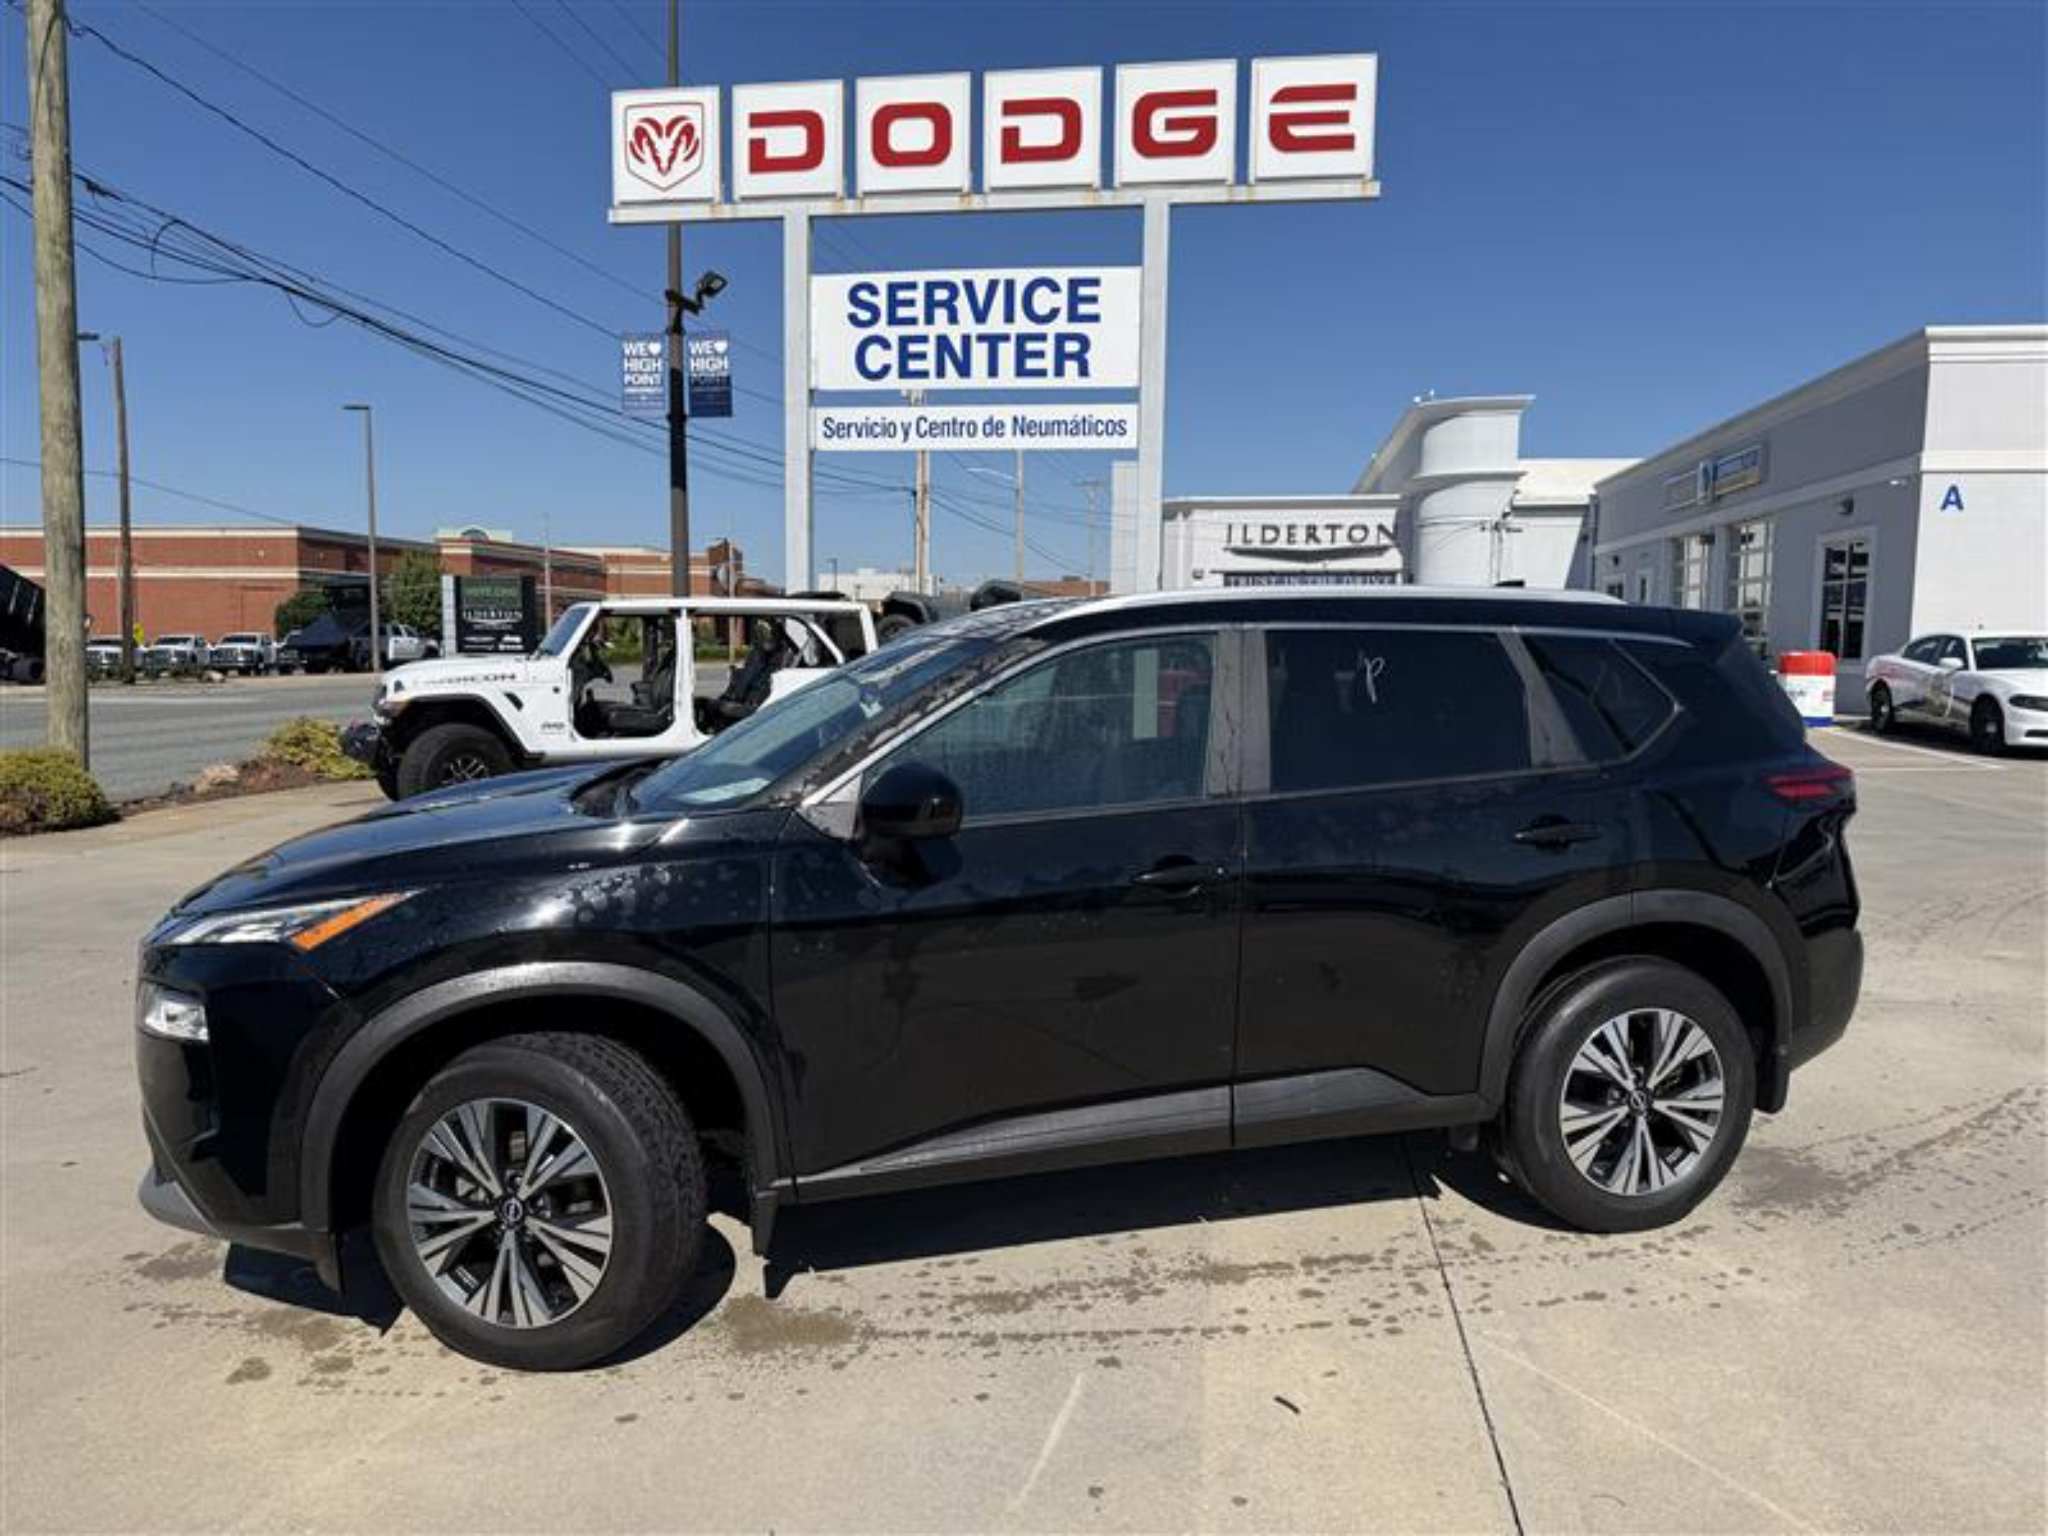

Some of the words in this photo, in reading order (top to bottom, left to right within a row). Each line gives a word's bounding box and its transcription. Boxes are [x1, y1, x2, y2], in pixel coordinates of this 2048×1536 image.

[748, 83, 1357, 174] DODGE
[847, 277, 1101, 328] SERVICE
[623, 341, 648, 356] WE
[689, 341, 714, 355] WE
[855, 332, 1091, 381] CENTER
[623, 357, 662, 372] HIGH
[690, 355, 729, 370] HIGH
[623, 372, 662, 385] POINT
[823, 416, 897, 439] Servicio
[901, 418, 912, 443] y
[915, 416, 978, 439] Centro
[982, 416, 1006, 438] de
[1012, 414, 1128, 438] Neumáticos
[1940, 484, 1965, 511] A
[1226, 522, 1397, 545] ILDERTON
